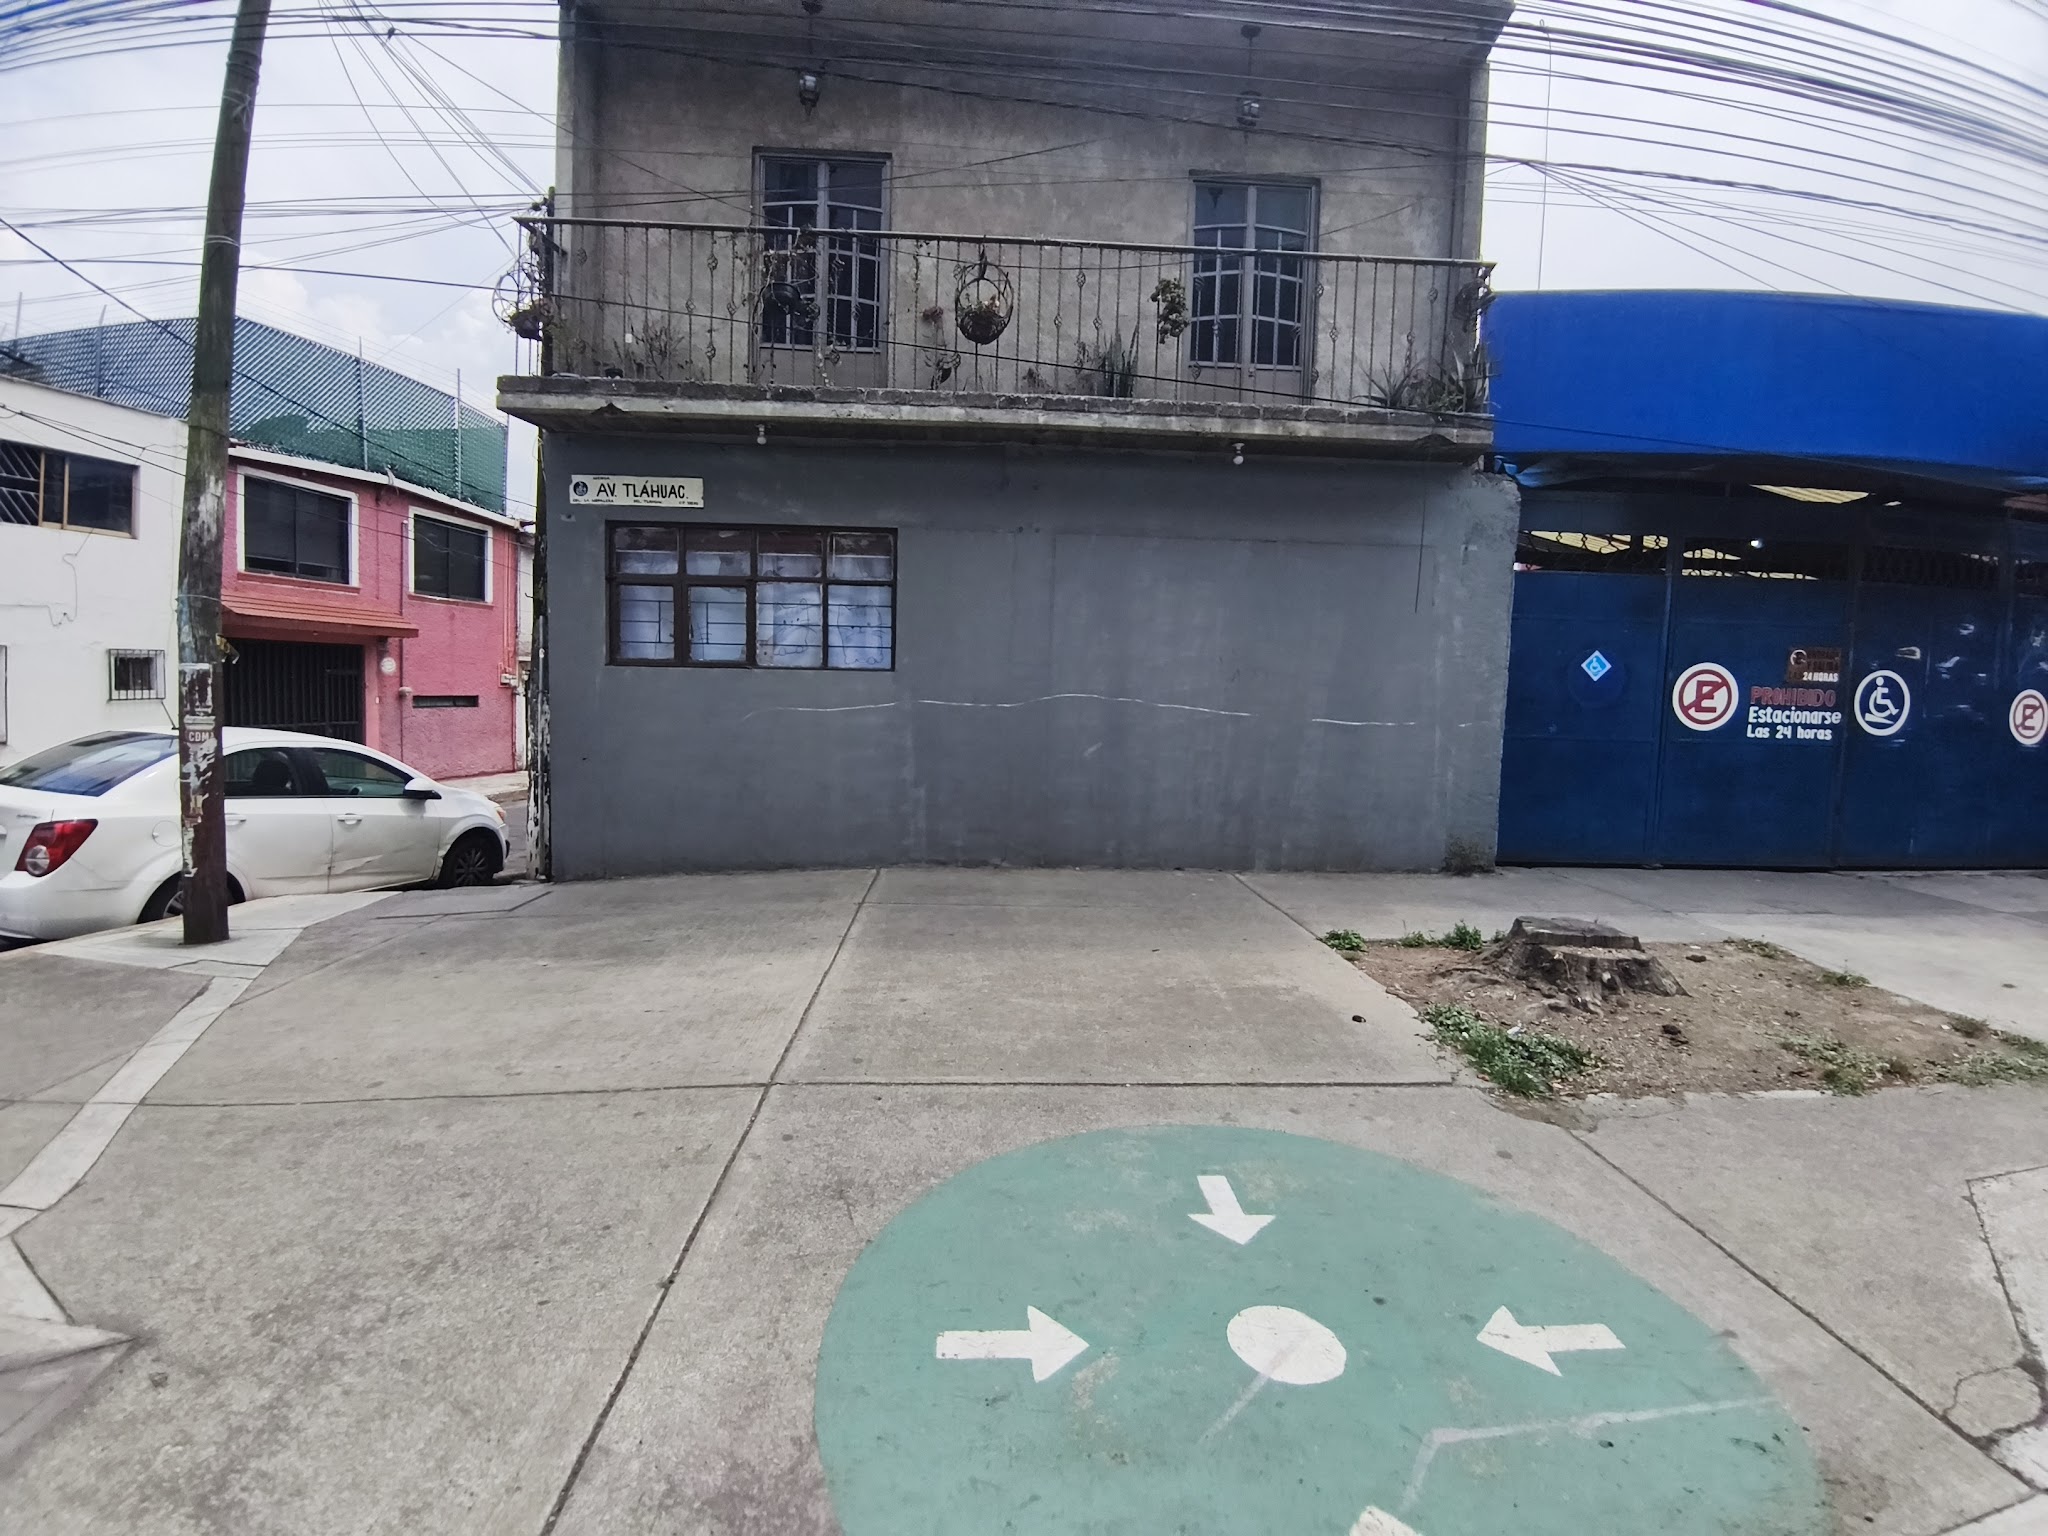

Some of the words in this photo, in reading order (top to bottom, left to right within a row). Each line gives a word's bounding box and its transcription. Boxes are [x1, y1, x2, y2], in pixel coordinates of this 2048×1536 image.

[596, 482, 618, 498] AV.
[1802, 671, 1813, 681] 24
[1813, 672, 1839, 682] HORAS
[1750, 685, 1836, 707] PROHIBIDO
[1748, 705, 1842, 725] Estacionarse
[1746, 724, 1770, 739] Las
[1775, 725, 1793, 739] 24
[1797, 726, 1833, 741] horas
